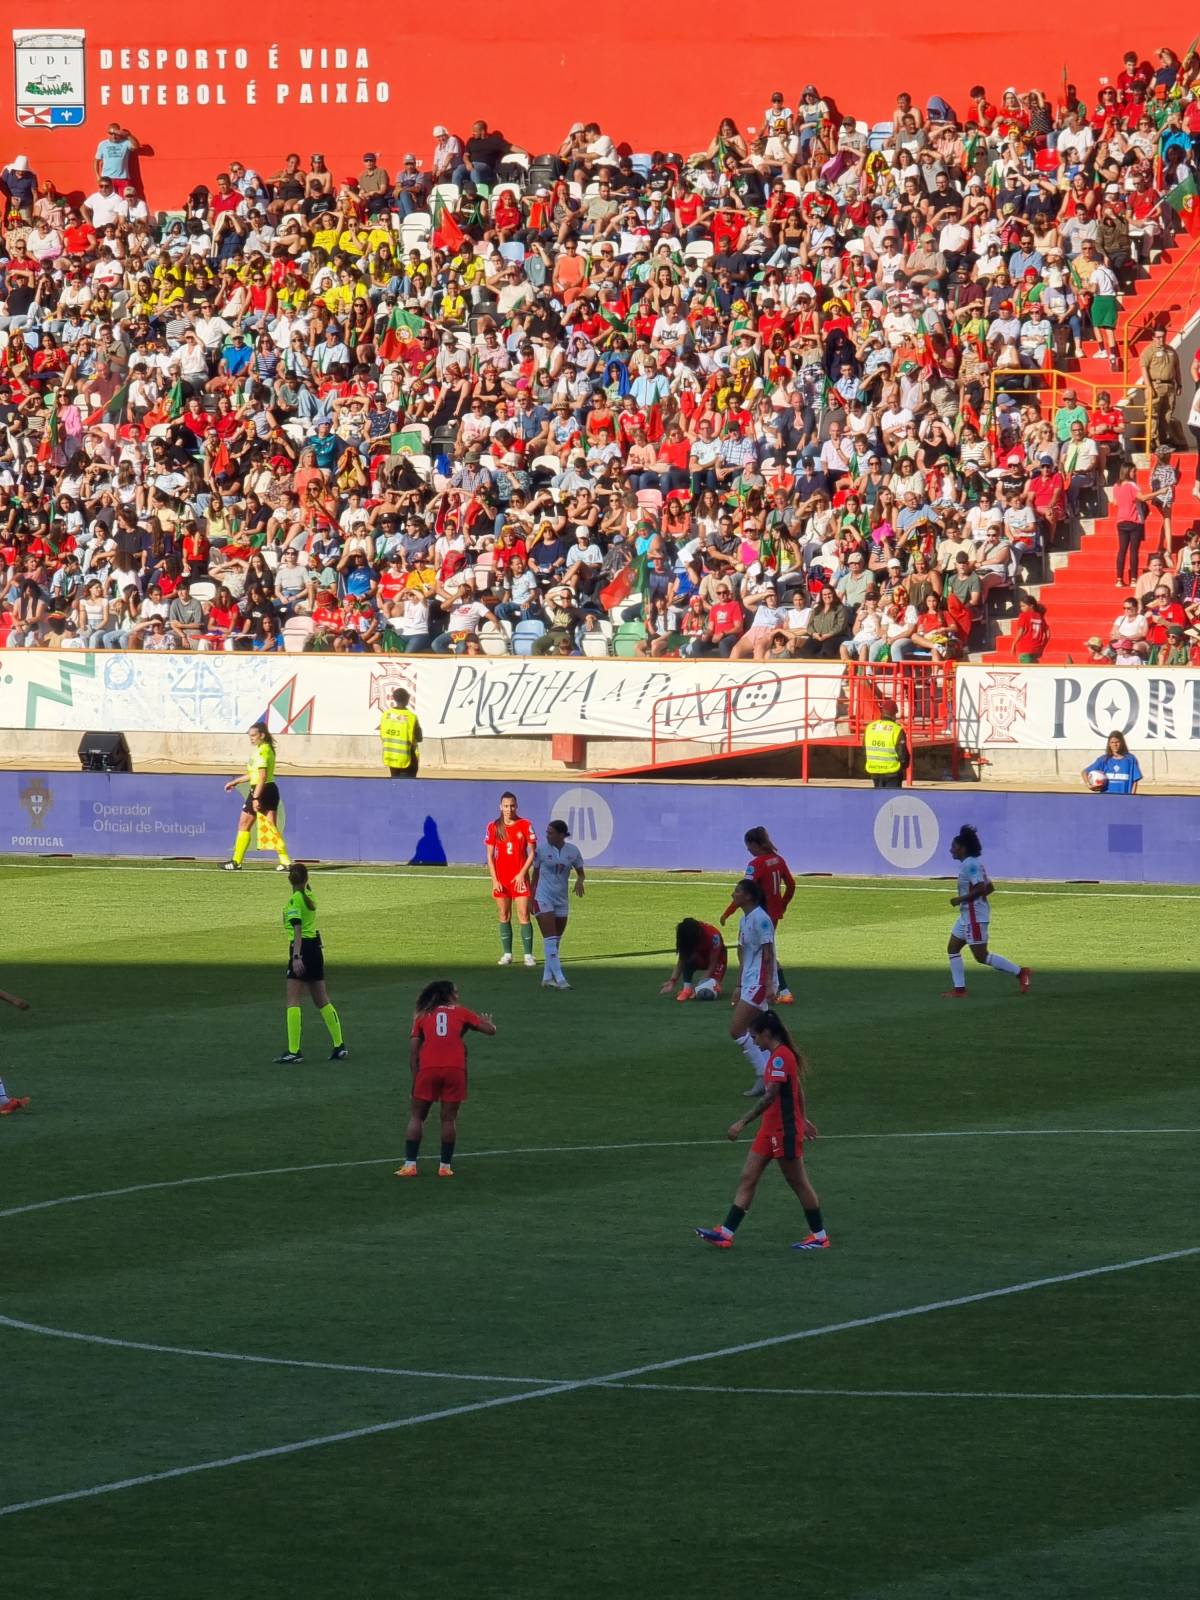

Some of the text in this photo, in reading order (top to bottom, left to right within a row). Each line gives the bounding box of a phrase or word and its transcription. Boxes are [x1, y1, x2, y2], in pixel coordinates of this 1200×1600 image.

[100, 43, 369, 70] DESPORTO É VIDA
[101, 77, 390, 105] FUTEBOL É PAIXÃO
[438, 663, 599, 734] PARTILHA
[92, 802, 152, 818] Operador
[92, 819, 206, 837] Oficial de Portugal
[11, 836, 65, 848] PORTUGAL
[506, 842, 513, 855] 2
[435, 1012, 448, 1037] 8
